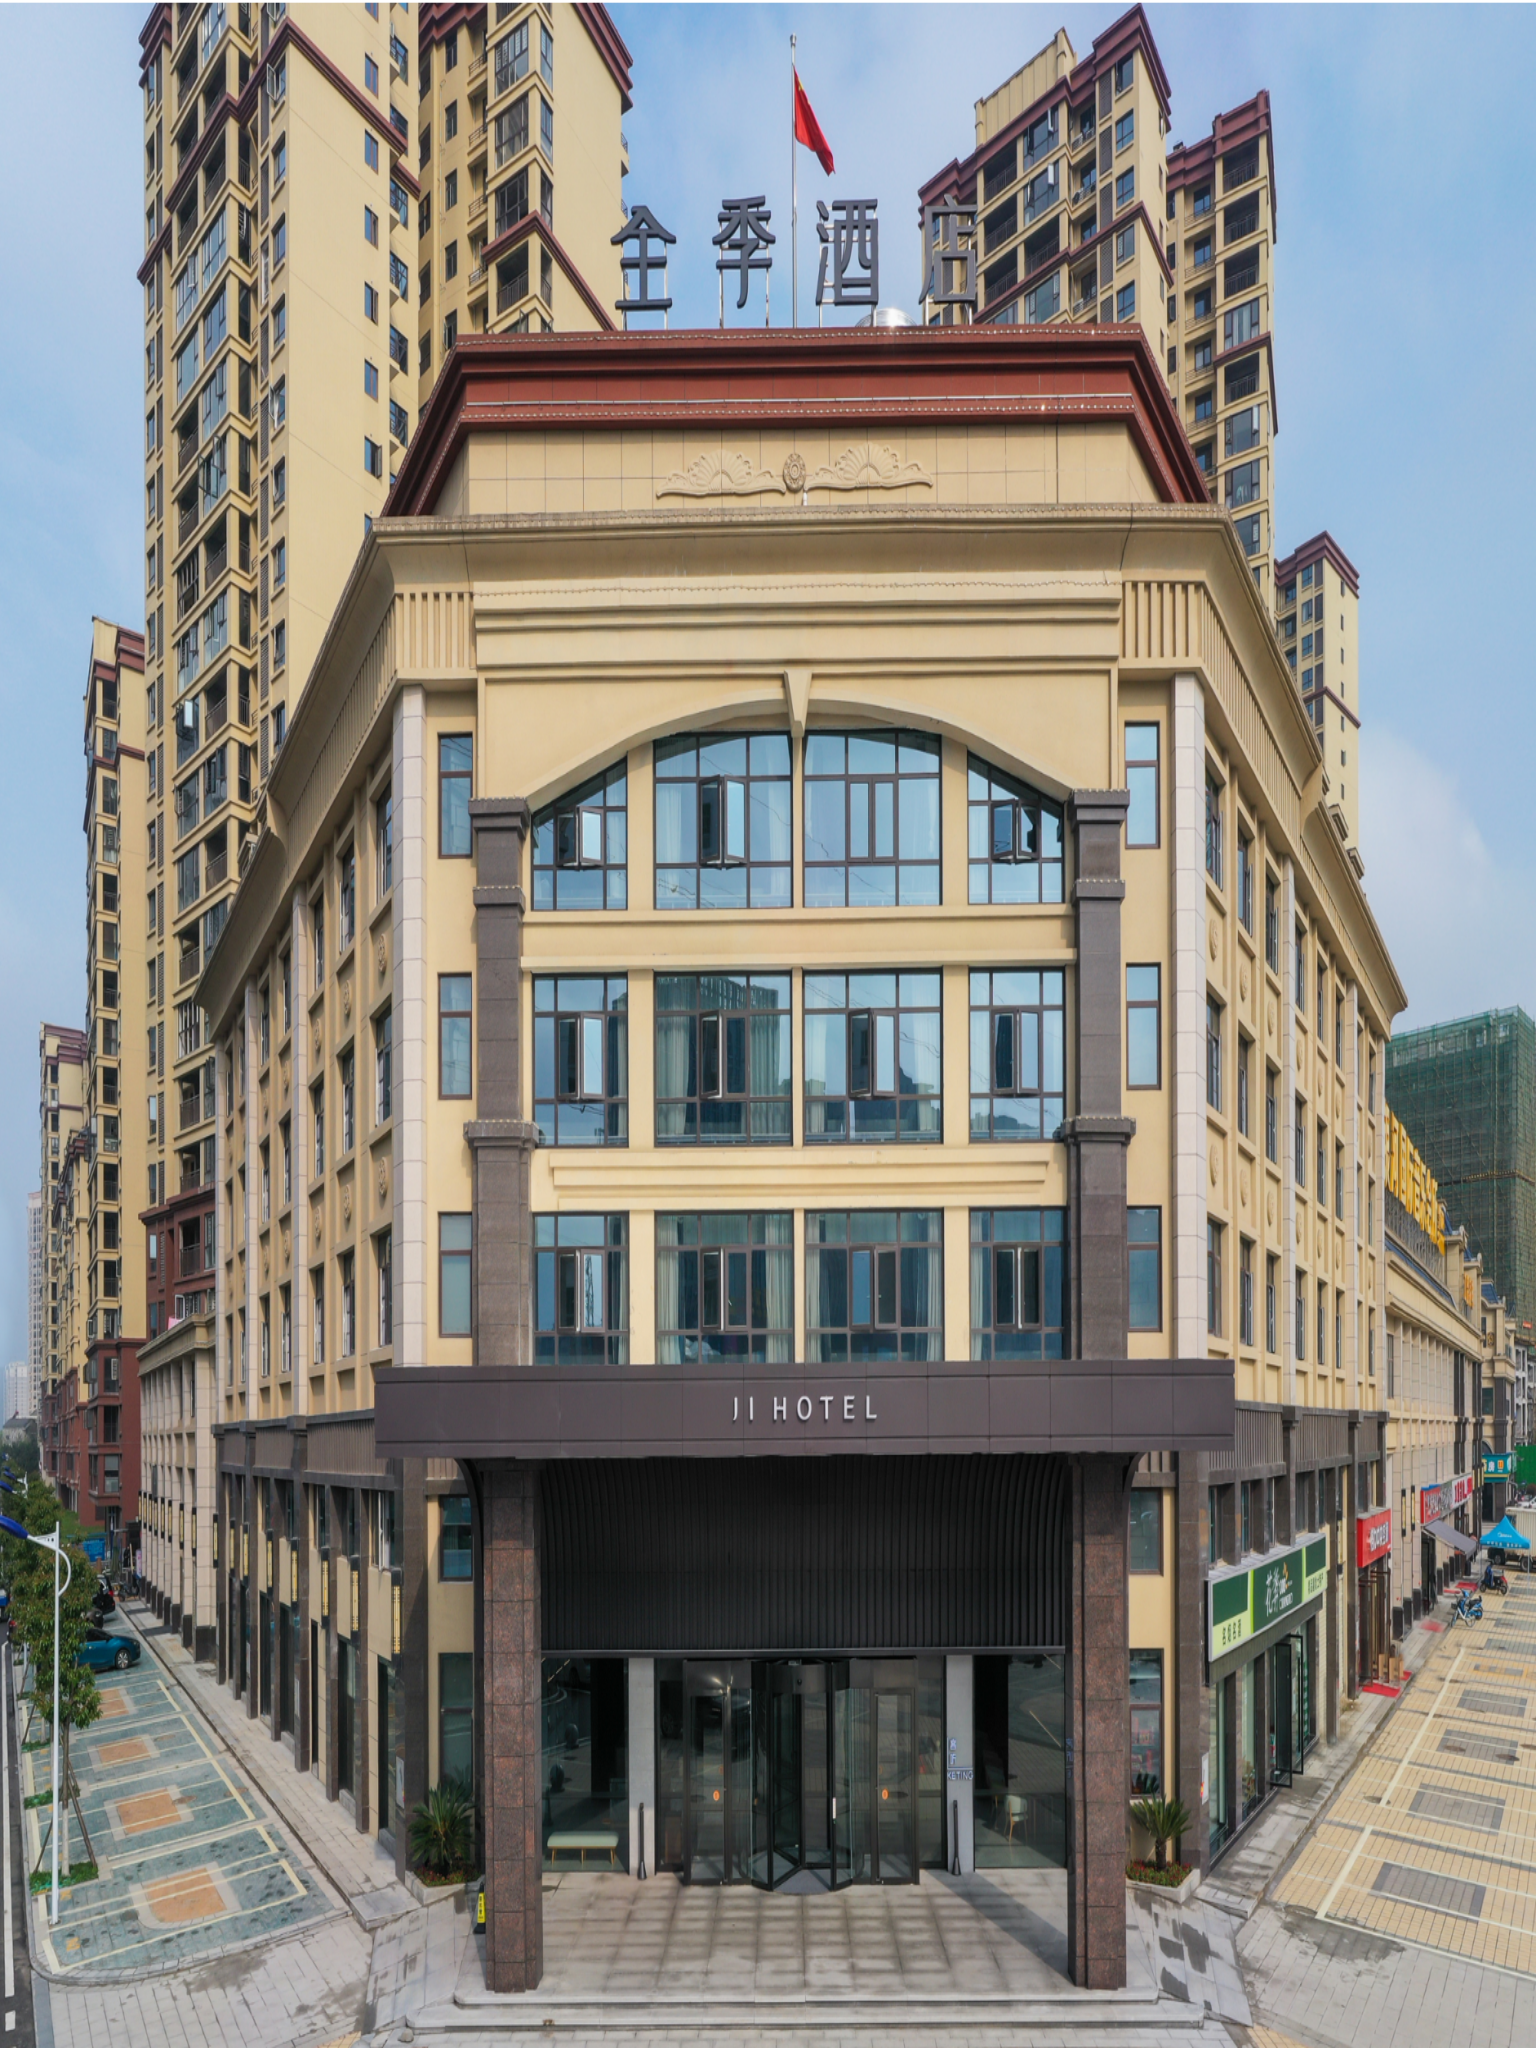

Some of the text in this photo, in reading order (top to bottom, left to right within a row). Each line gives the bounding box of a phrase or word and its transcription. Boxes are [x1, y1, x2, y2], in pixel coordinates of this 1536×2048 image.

[610, 194, 978, 310] 全季酒店
[732, 1395, 877, 1421] JI HOTEL
